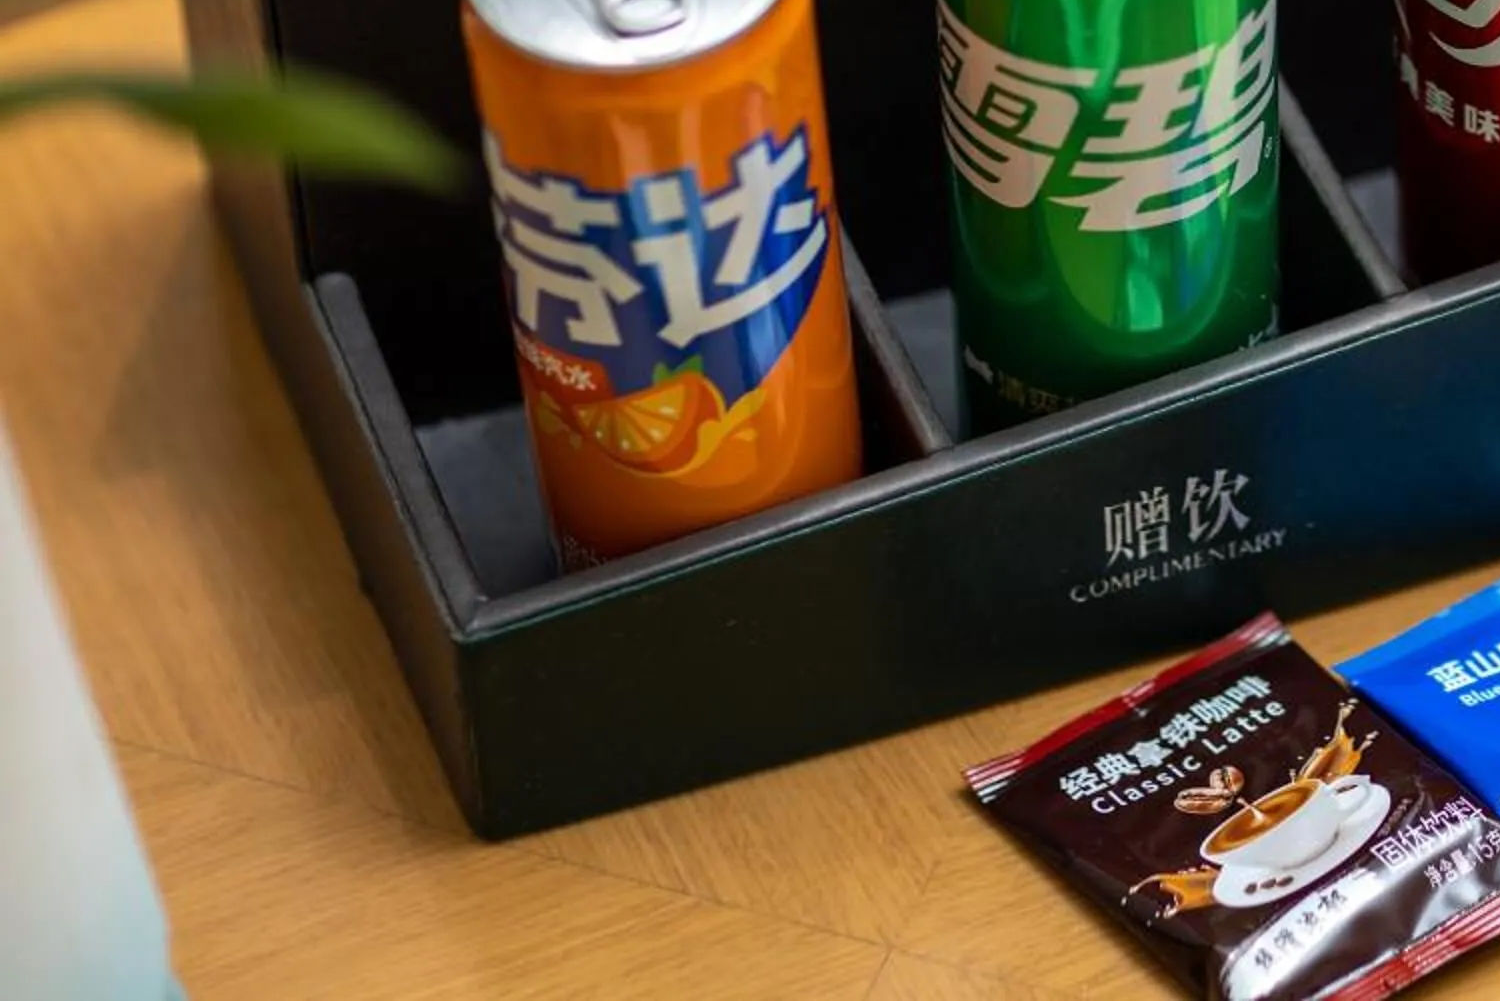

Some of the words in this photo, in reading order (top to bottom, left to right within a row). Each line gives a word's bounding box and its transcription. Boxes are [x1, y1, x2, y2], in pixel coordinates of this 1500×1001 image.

[485, 129, 827, 347] 芬达
[1070, 528, 1287, 603] COMPLIMENTARY
[1104, 468, 1251, 568] 赠饮
[1059, 676, 1272, 800] 经典拿铁咖啡
[1091, 755, 1201, 814] Classic
[1202, 700, 1286, 754] Latte
[1370, 796, 1487, 869] 固体饮料
